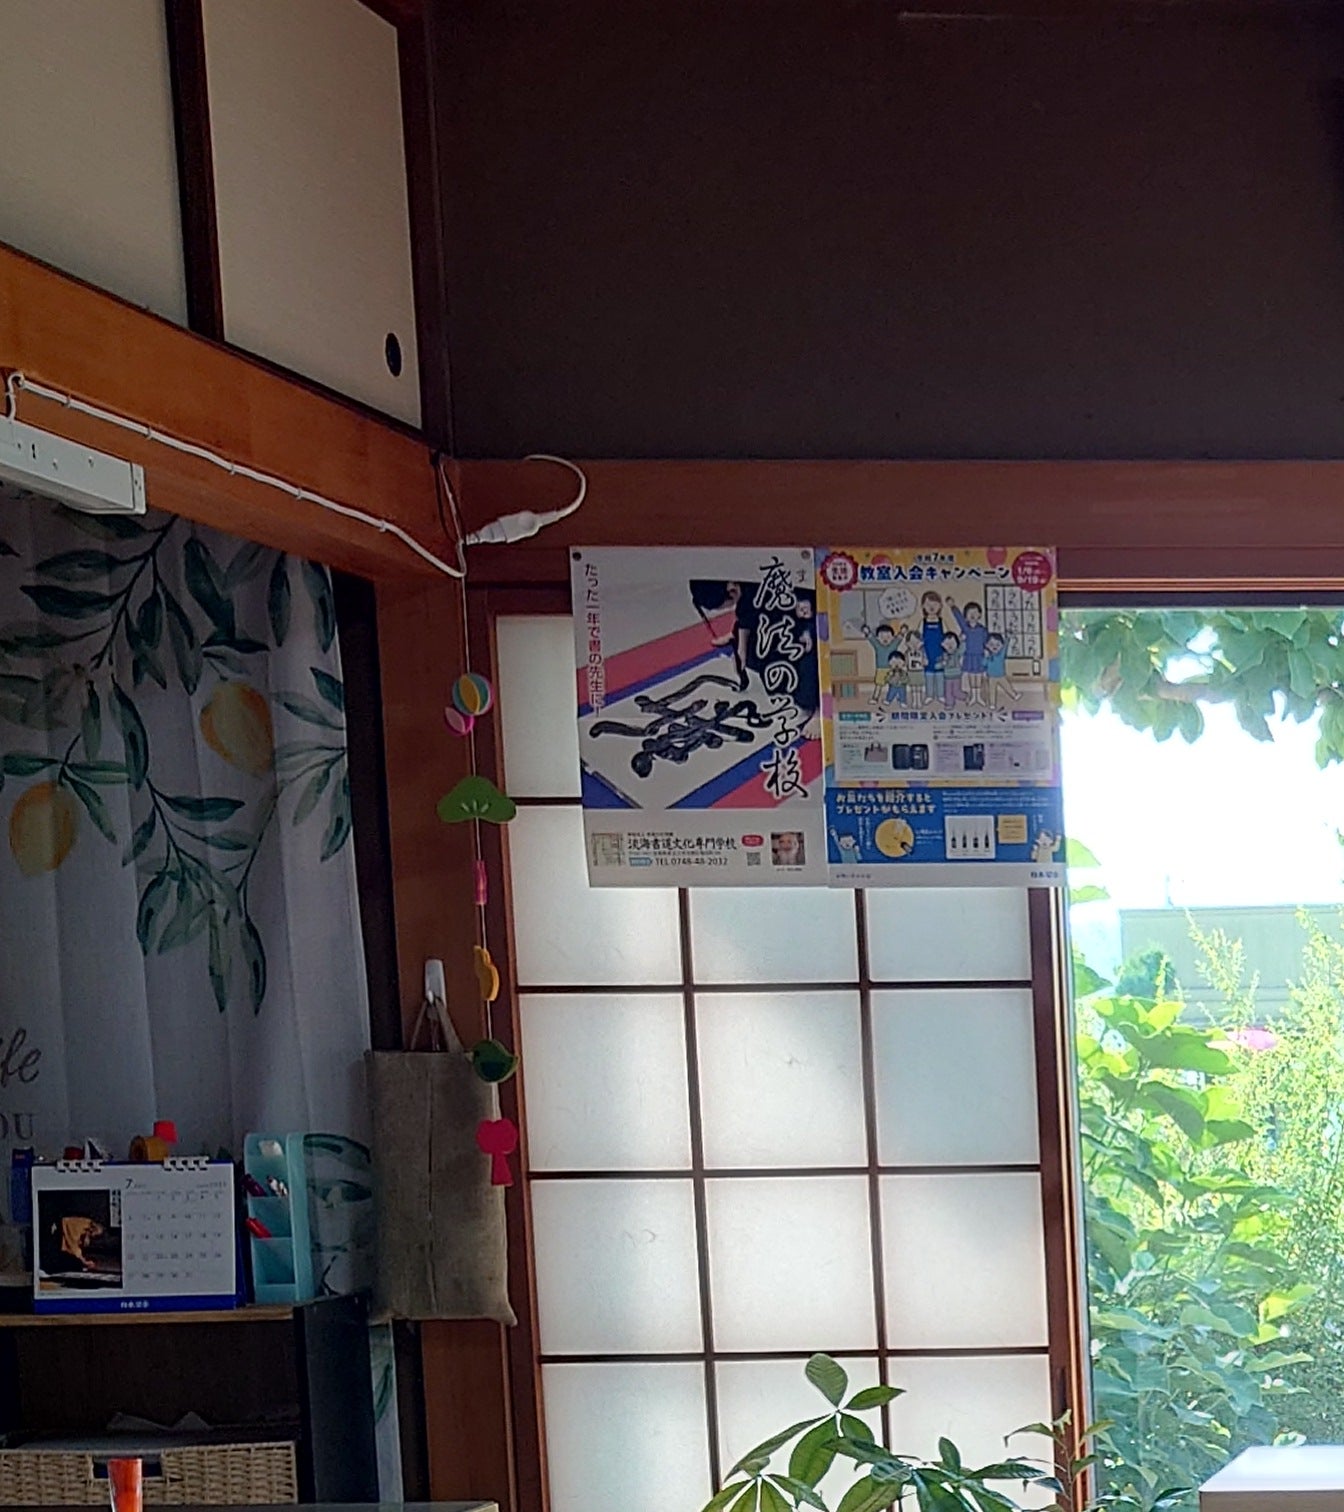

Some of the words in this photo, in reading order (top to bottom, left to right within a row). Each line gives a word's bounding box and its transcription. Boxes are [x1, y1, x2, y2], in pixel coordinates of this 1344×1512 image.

[860, 565, 1010, 581] 教室入会キャンペーン
[753, 557, 808, 798] 魔法の学校
